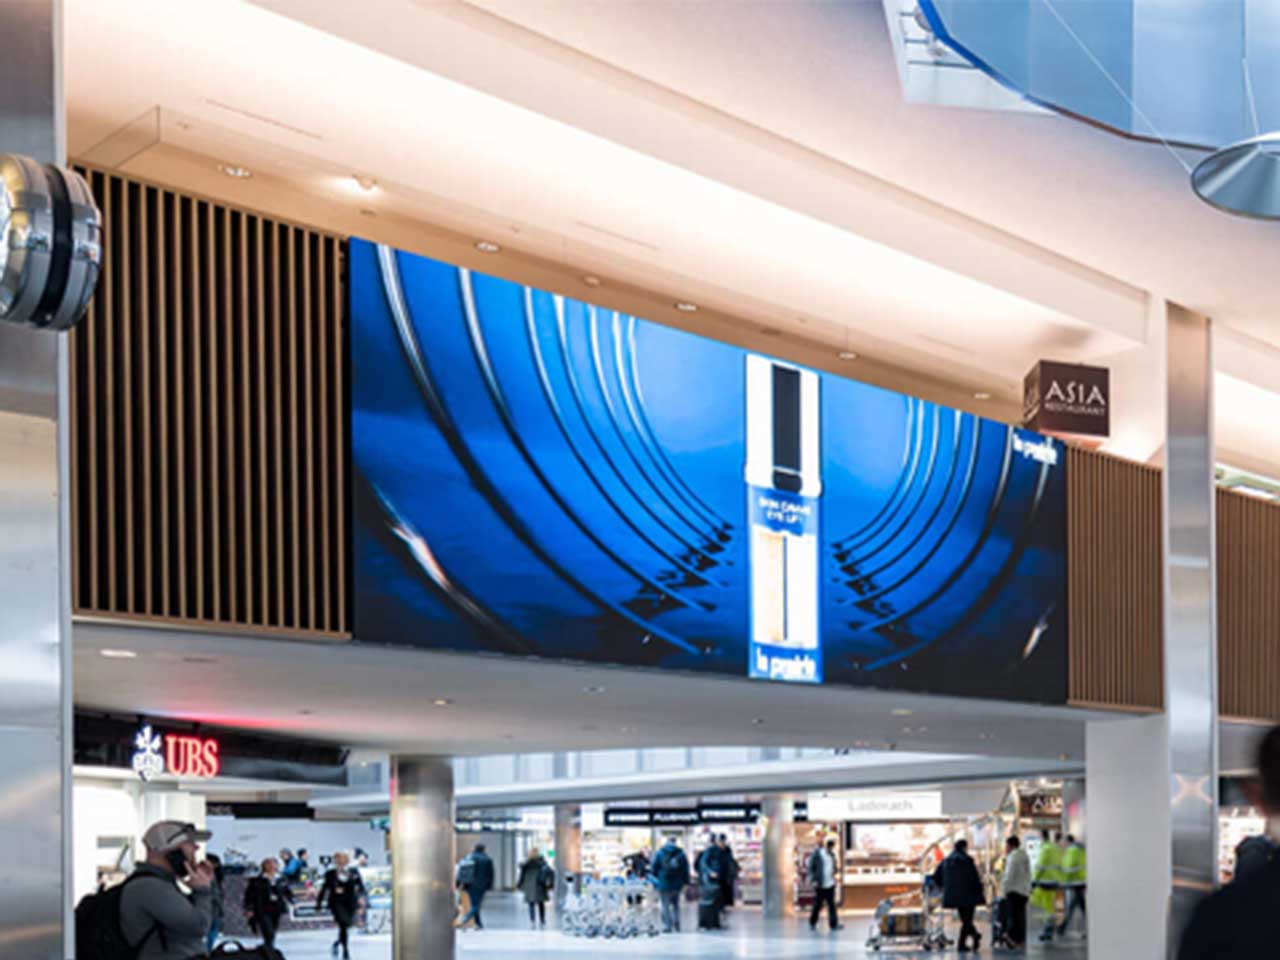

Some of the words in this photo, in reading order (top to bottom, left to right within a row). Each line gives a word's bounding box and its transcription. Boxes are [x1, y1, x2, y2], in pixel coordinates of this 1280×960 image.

[1044, 379, 1106, 405] ASIA
[1043, 401, 1106, 416] RESTAURANT
[165, 733, 219, 779] UBS
